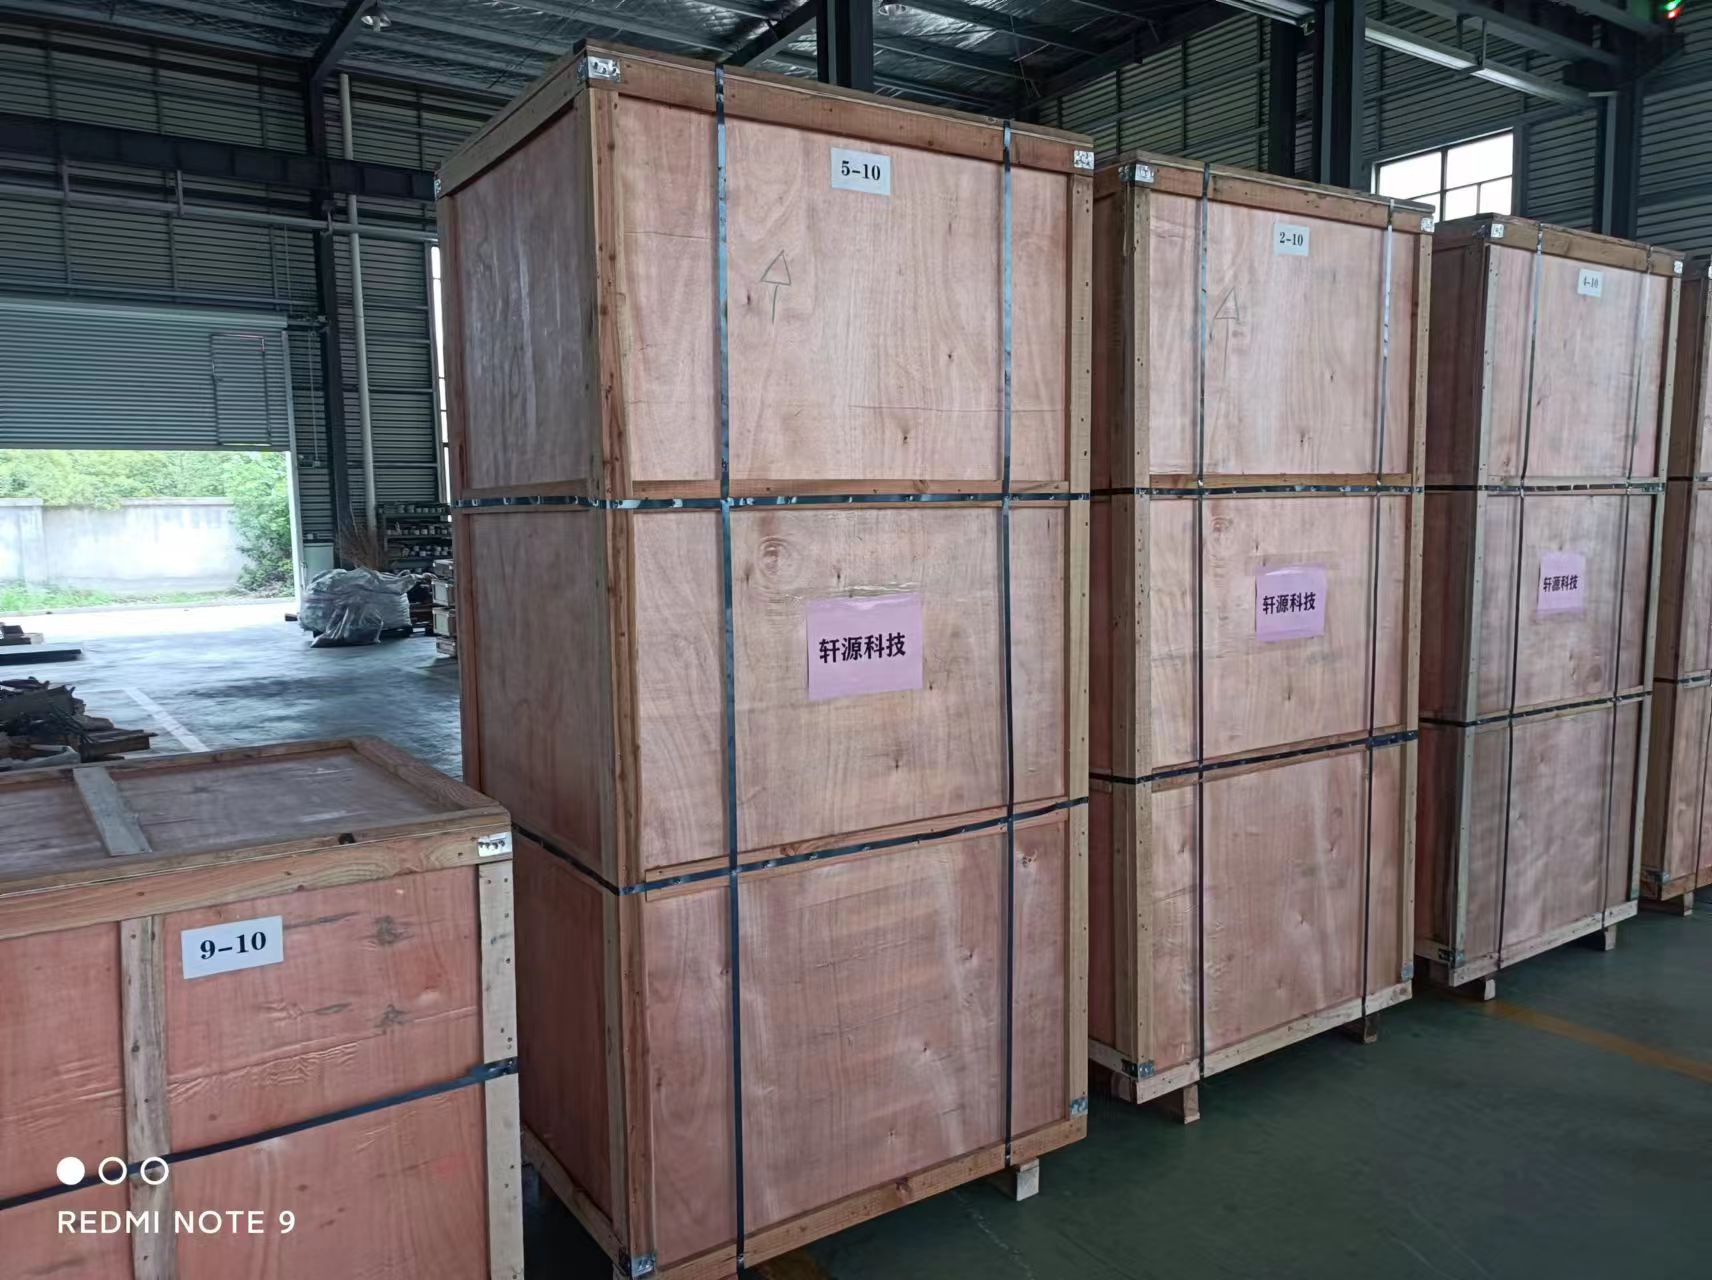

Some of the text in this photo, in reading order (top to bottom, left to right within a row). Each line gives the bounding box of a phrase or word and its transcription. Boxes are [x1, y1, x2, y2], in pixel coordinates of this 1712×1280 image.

[841, 160, 880, 181] 5-10
[1279, 231, 1304, 246] 2-10
[1543, 574, 1578, 592] 轩源科技
[1262, 591, 1316, 615] 轩源科技
[818, 632, 907, 663] 轩源科技
[200, 931, 267, 960] 9-10
